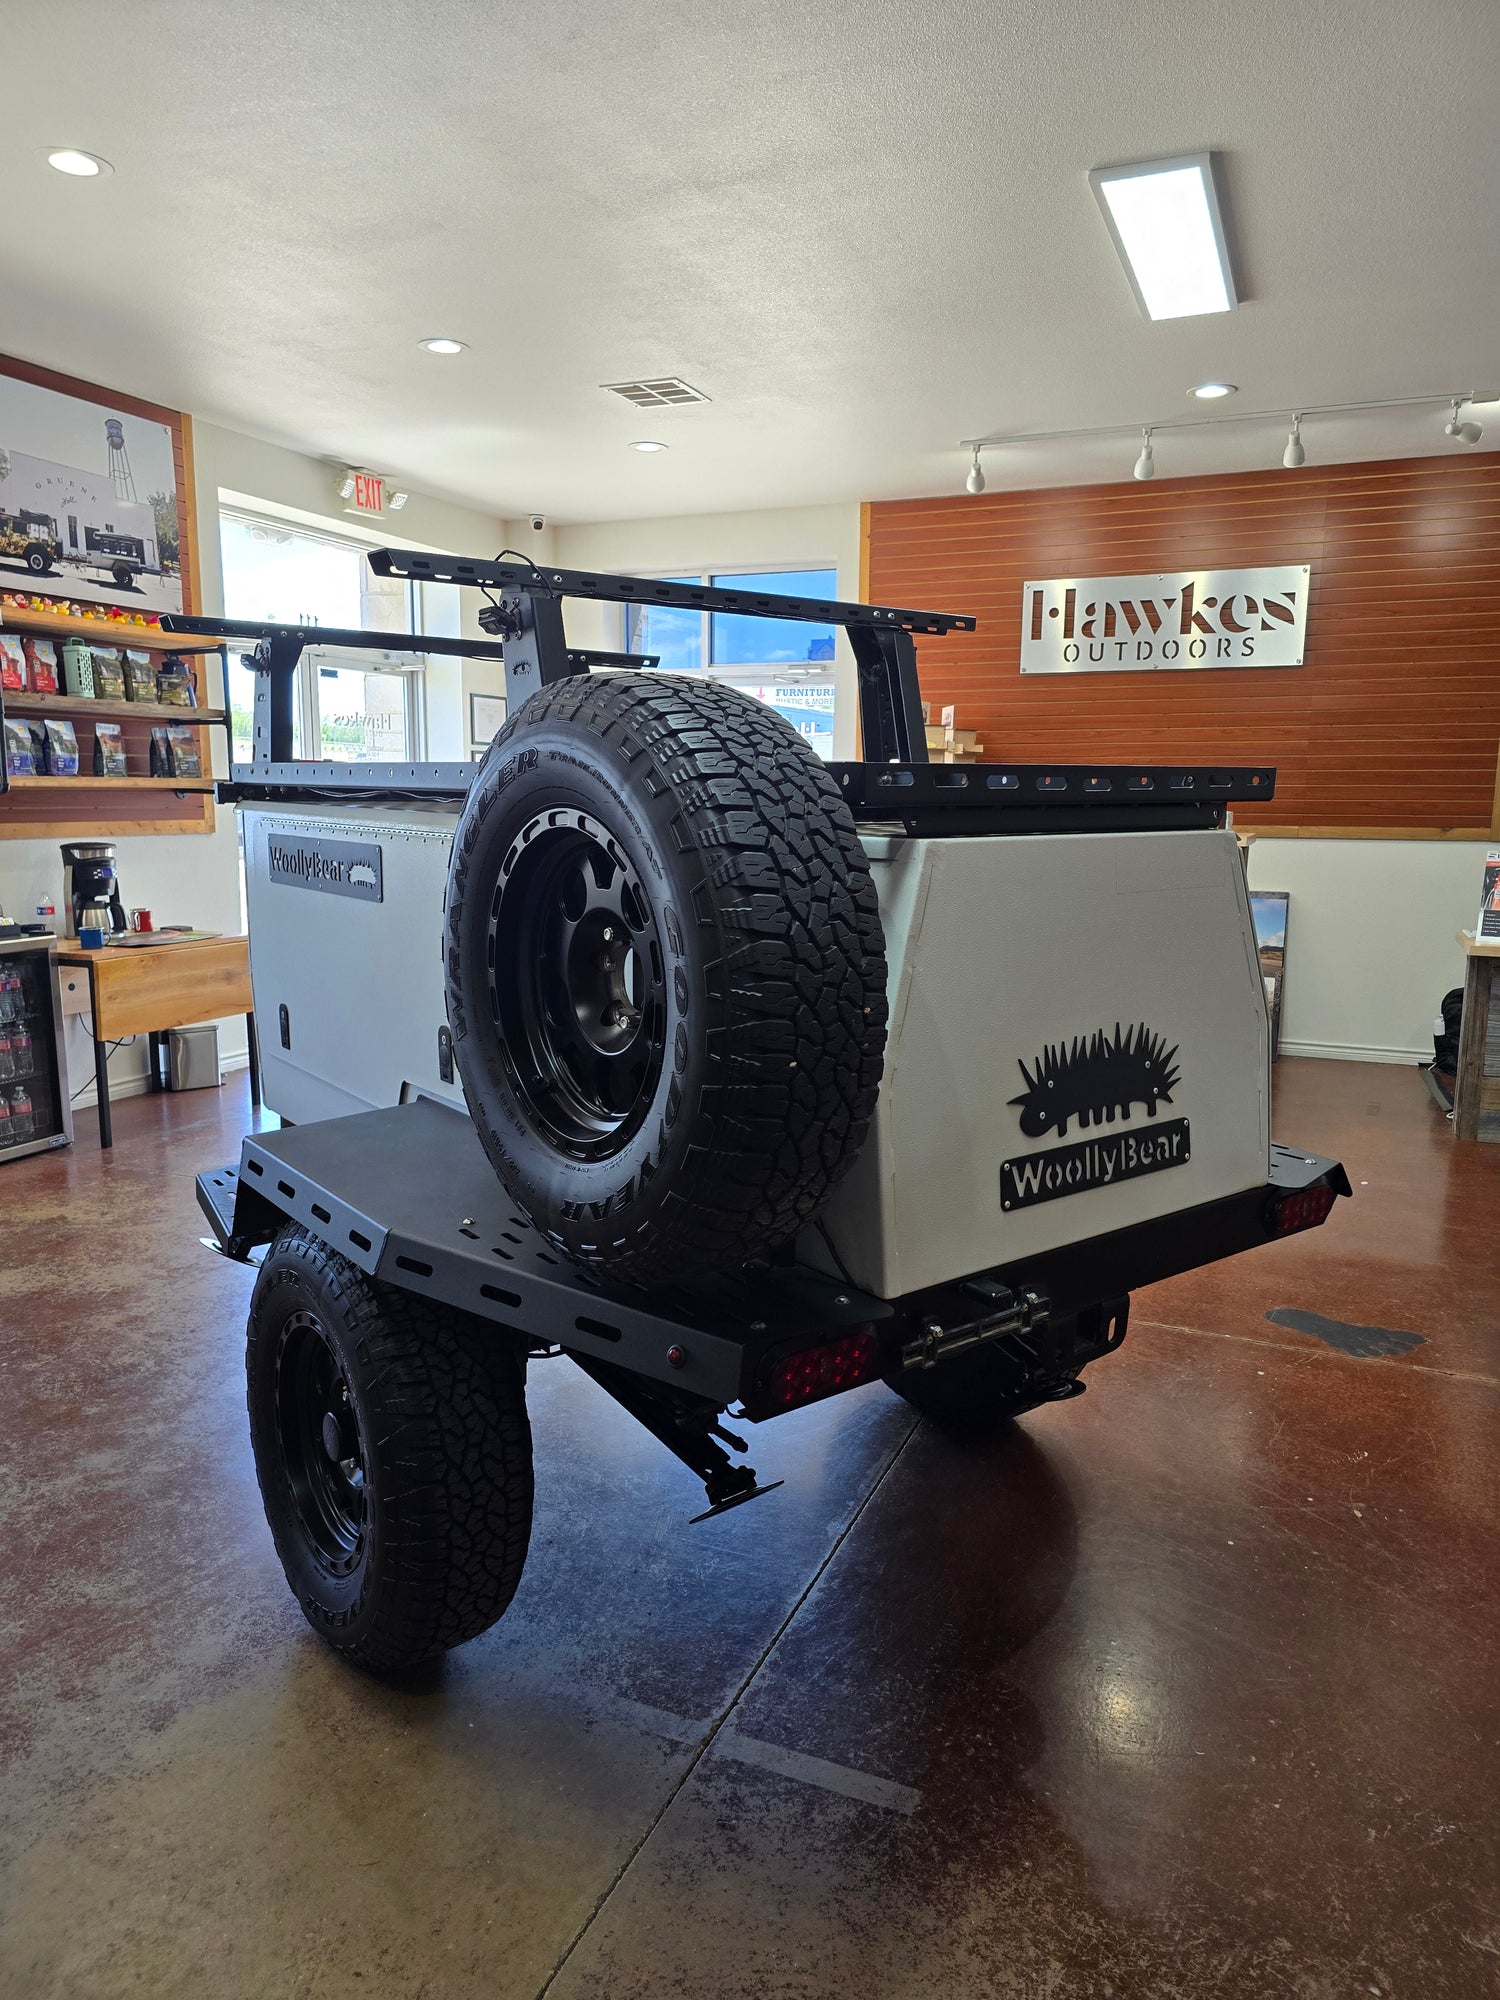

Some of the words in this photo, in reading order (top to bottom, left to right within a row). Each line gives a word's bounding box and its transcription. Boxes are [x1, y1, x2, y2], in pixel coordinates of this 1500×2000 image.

[355, 474, 382, 511] EXIT
[1031, 581, 1296, 641] Hawkes
[1063, 637, 1255, 663] OUTDOORS
[269, 846, 344, 882] WoollyBear
[448, 746, 539, 1042] WRANGLER
[1012, 1132, 1182, 1198] WoollyBear
